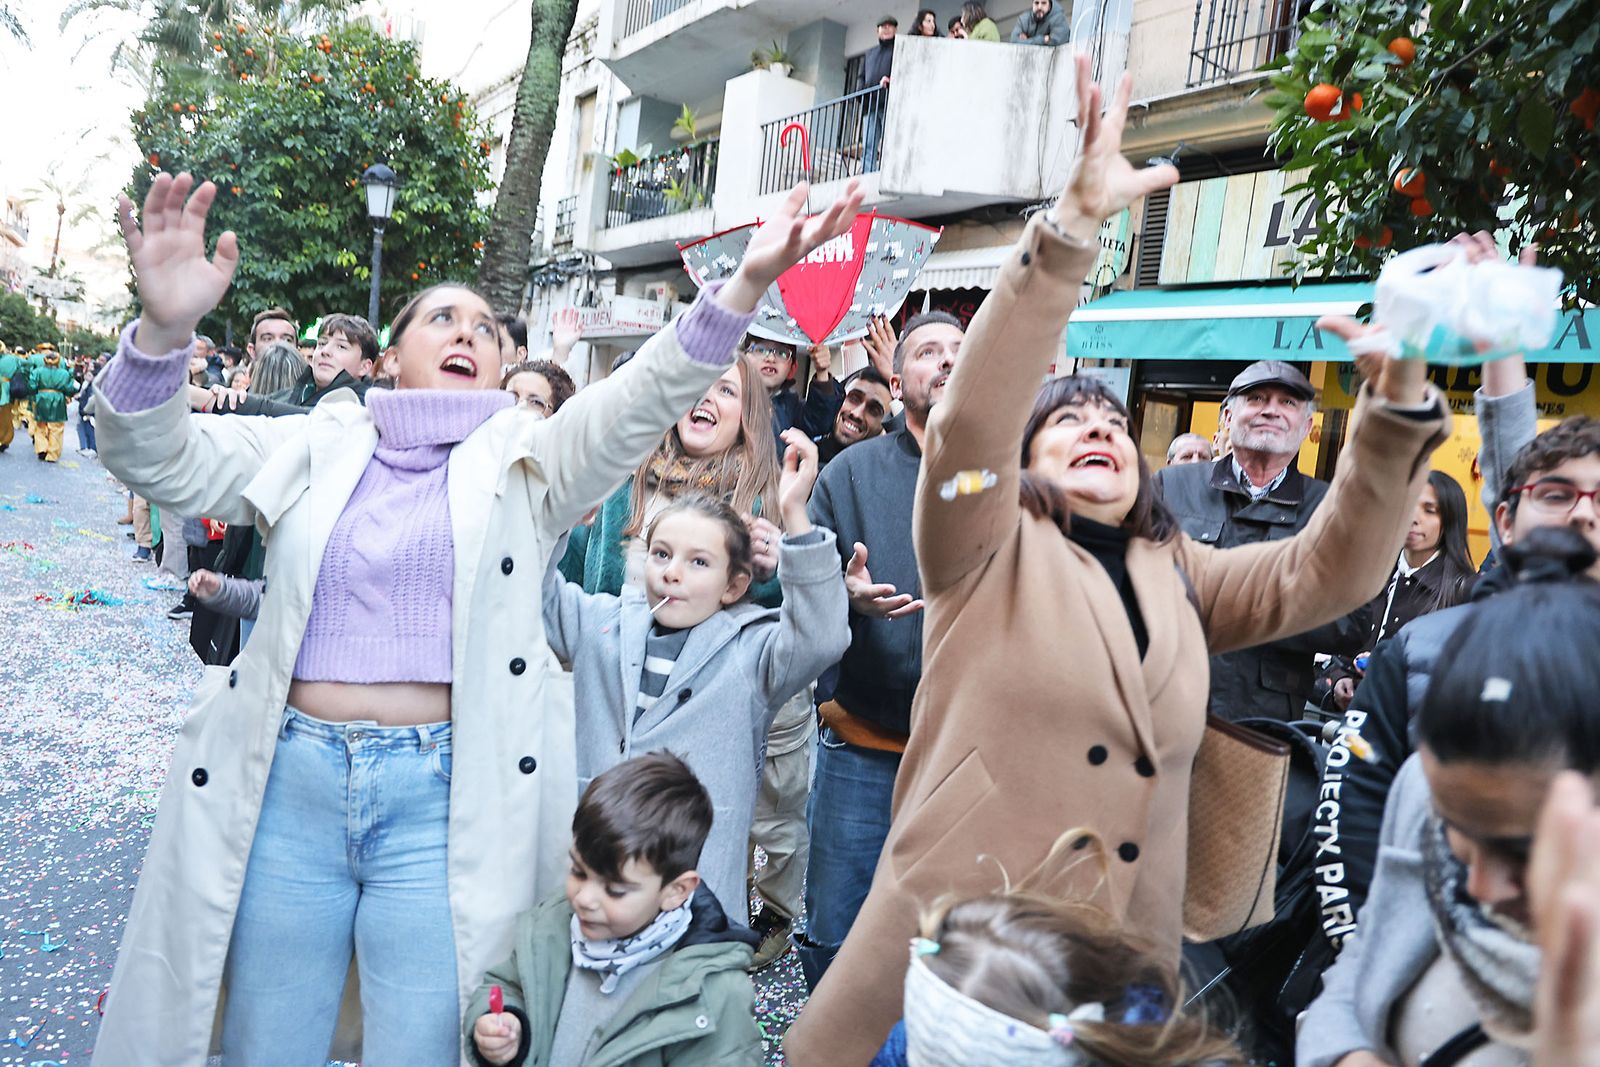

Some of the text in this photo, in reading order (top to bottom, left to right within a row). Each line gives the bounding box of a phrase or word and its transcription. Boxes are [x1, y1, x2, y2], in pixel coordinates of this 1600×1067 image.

[1264, 195, 1330, 247] LA
[1097, 235, 1126, 254] ALETA
[582, 310, 612, 326] ALIMEN
[1274, 320, 1324, 349] LA
